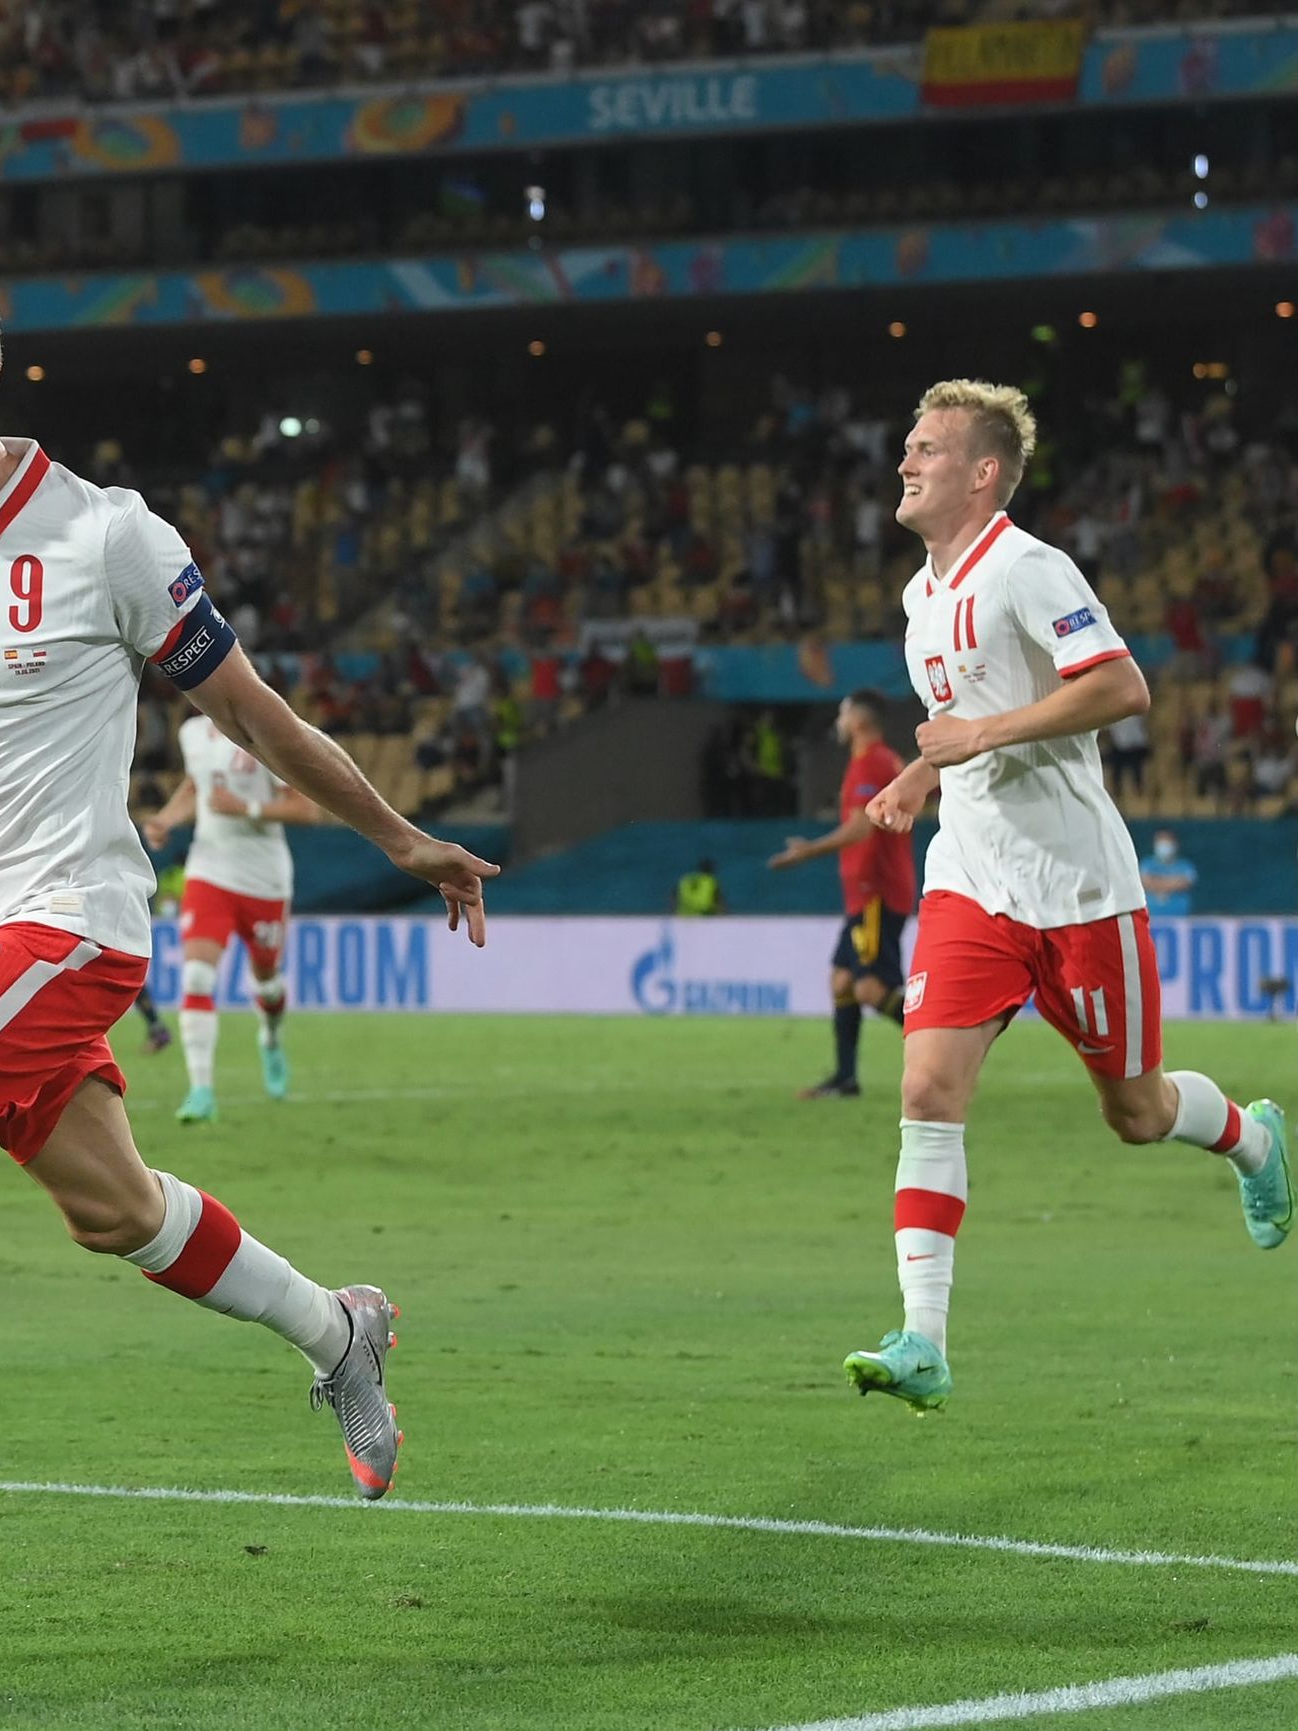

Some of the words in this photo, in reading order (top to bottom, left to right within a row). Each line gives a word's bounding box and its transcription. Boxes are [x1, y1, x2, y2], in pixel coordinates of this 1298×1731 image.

[590, 77, 756, 128] SEVILLE
[9, 554, 43, 632] 9
[954, 593, 977, 651] 11
[164, 629, 211, 674] RESPECT
[684, 980, 788, 1013] GAZPROM
[1071, 986, 1109, 1036] 11
